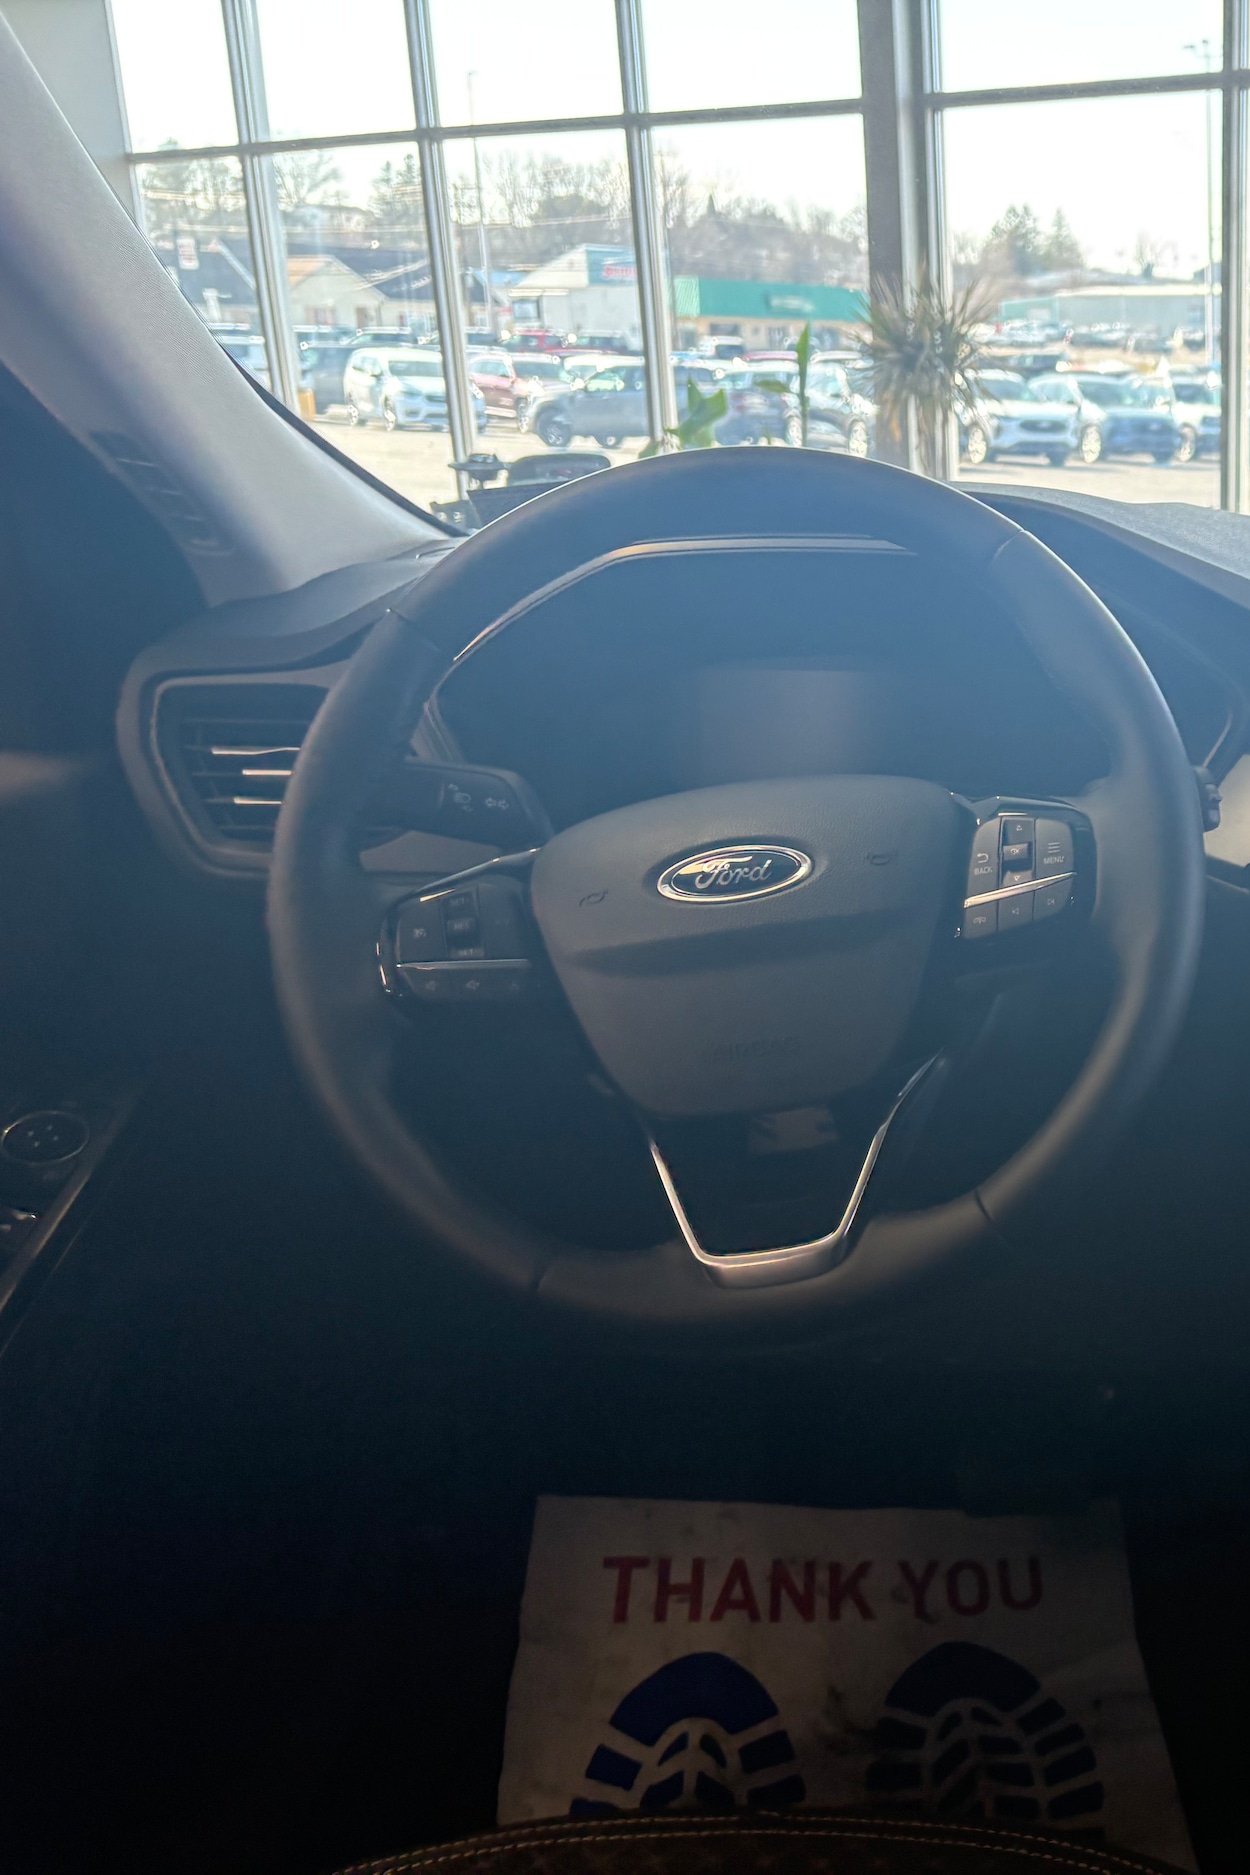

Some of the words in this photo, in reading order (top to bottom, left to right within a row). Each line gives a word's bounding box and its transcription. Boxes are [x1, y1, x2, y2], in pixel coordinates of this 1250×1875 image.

[974, 866, 993, 876] BACK
[1043, 855, 1065, 865] MENU
[694, 855, 773, 889] Ford
[602, 1555, 878, 1624] THANK
[897, 1555, 1045, 1622] YOU
